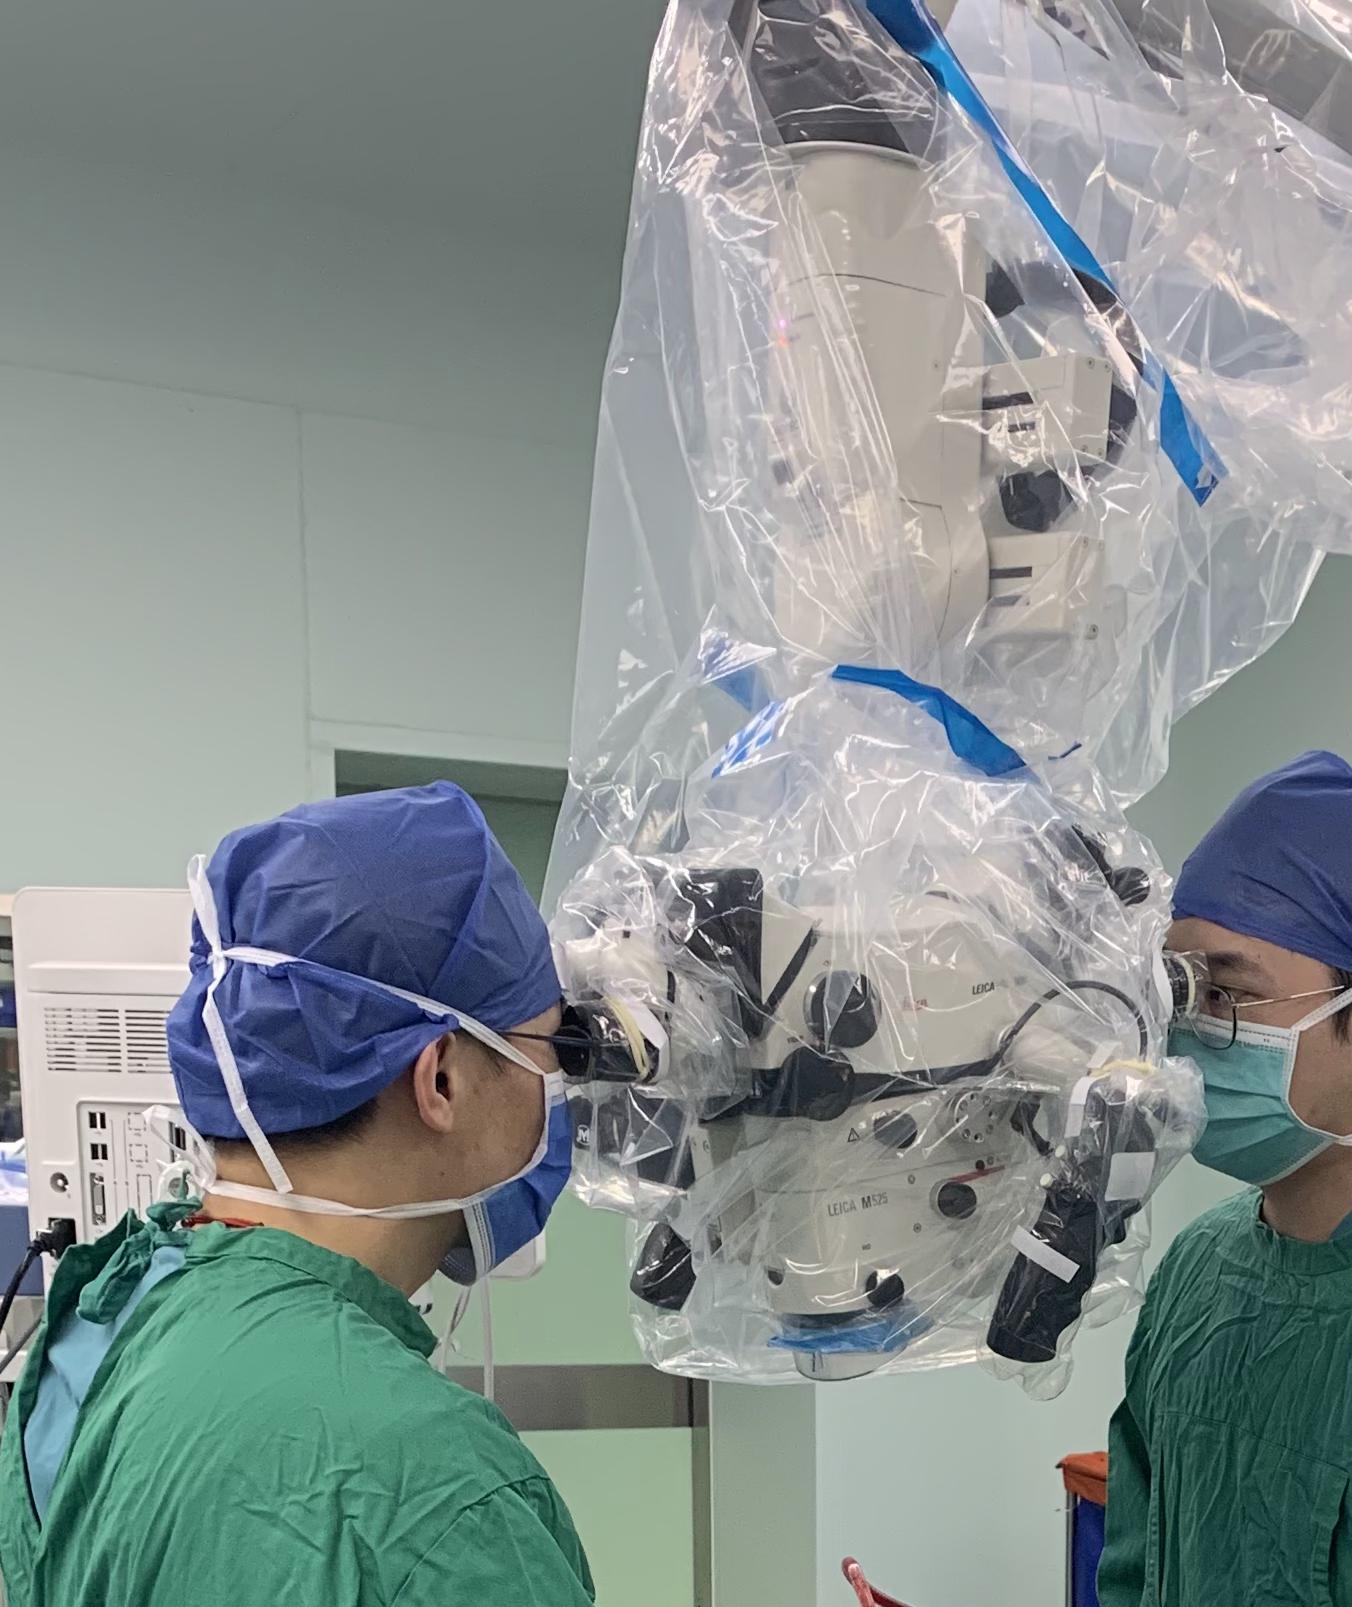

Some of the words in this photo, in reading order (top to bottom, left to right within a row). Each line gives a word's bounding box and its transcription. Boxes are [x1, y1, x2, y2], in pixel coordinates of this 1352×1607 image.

[972, 981, 995, 995] LEICA
[827, 1200, 857, 1217] LEICA
[861, 1192, 889, 1209] M525
